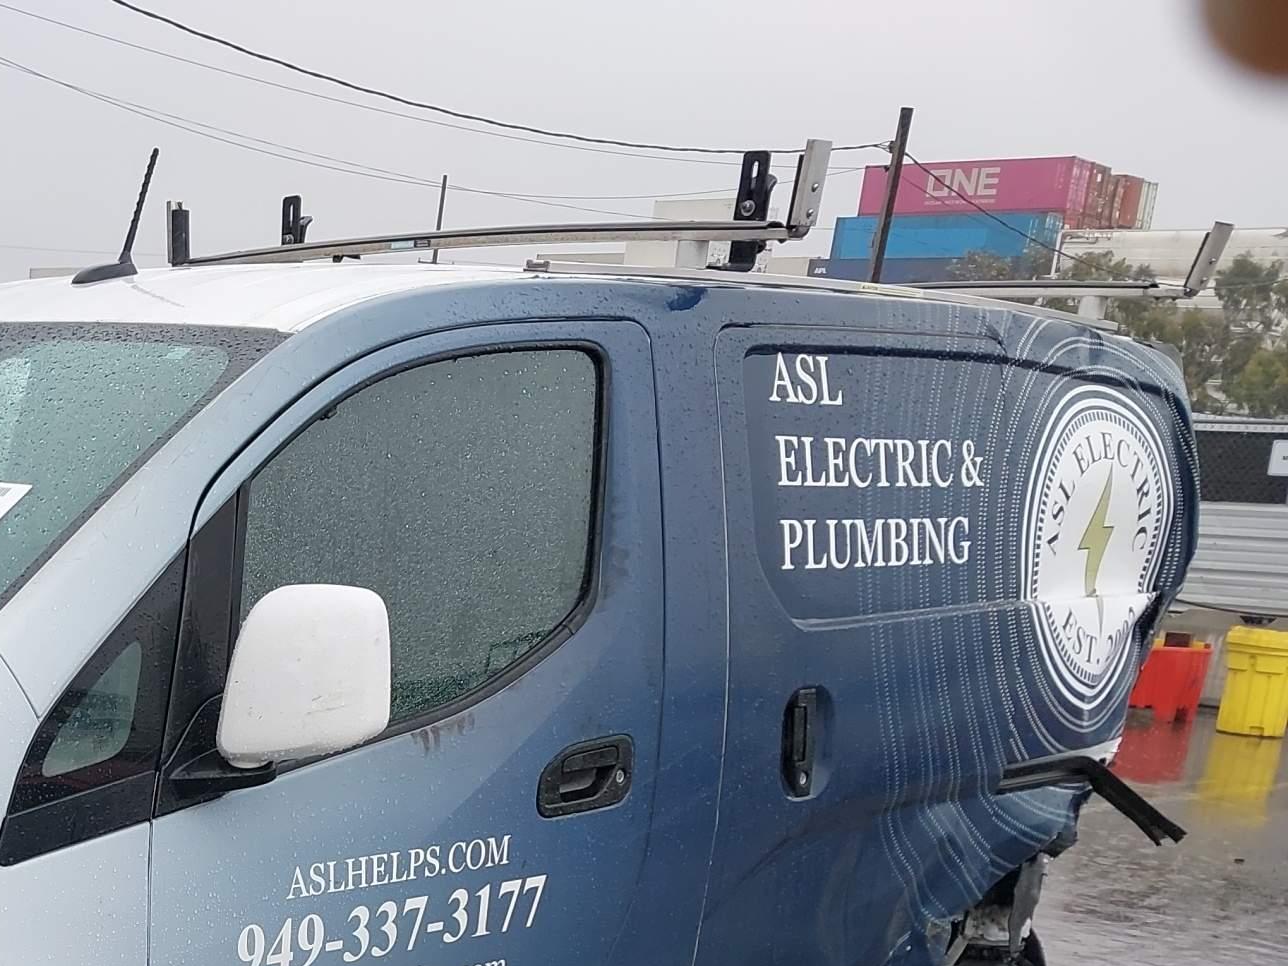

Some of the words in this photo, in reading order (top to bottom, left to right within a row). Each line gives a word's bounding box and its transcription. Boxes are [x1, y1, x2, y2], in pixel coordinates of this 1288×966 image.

[925, 167, 1001, 197] ONE
[769, 352, 843, 406] ASL
[775, 435, 954, 488] ELECTRIC
[961, 439, 985, 487] &
[1045, 479, 1076, 556] ASL
[1072, 431, 1152, 552] ELECTRIC
[780, 516, 972, 570] PLUMBING
[1062, 608, 1101, 665] EST.
[286, 834, 512, 900] ASLHELPS.COM
